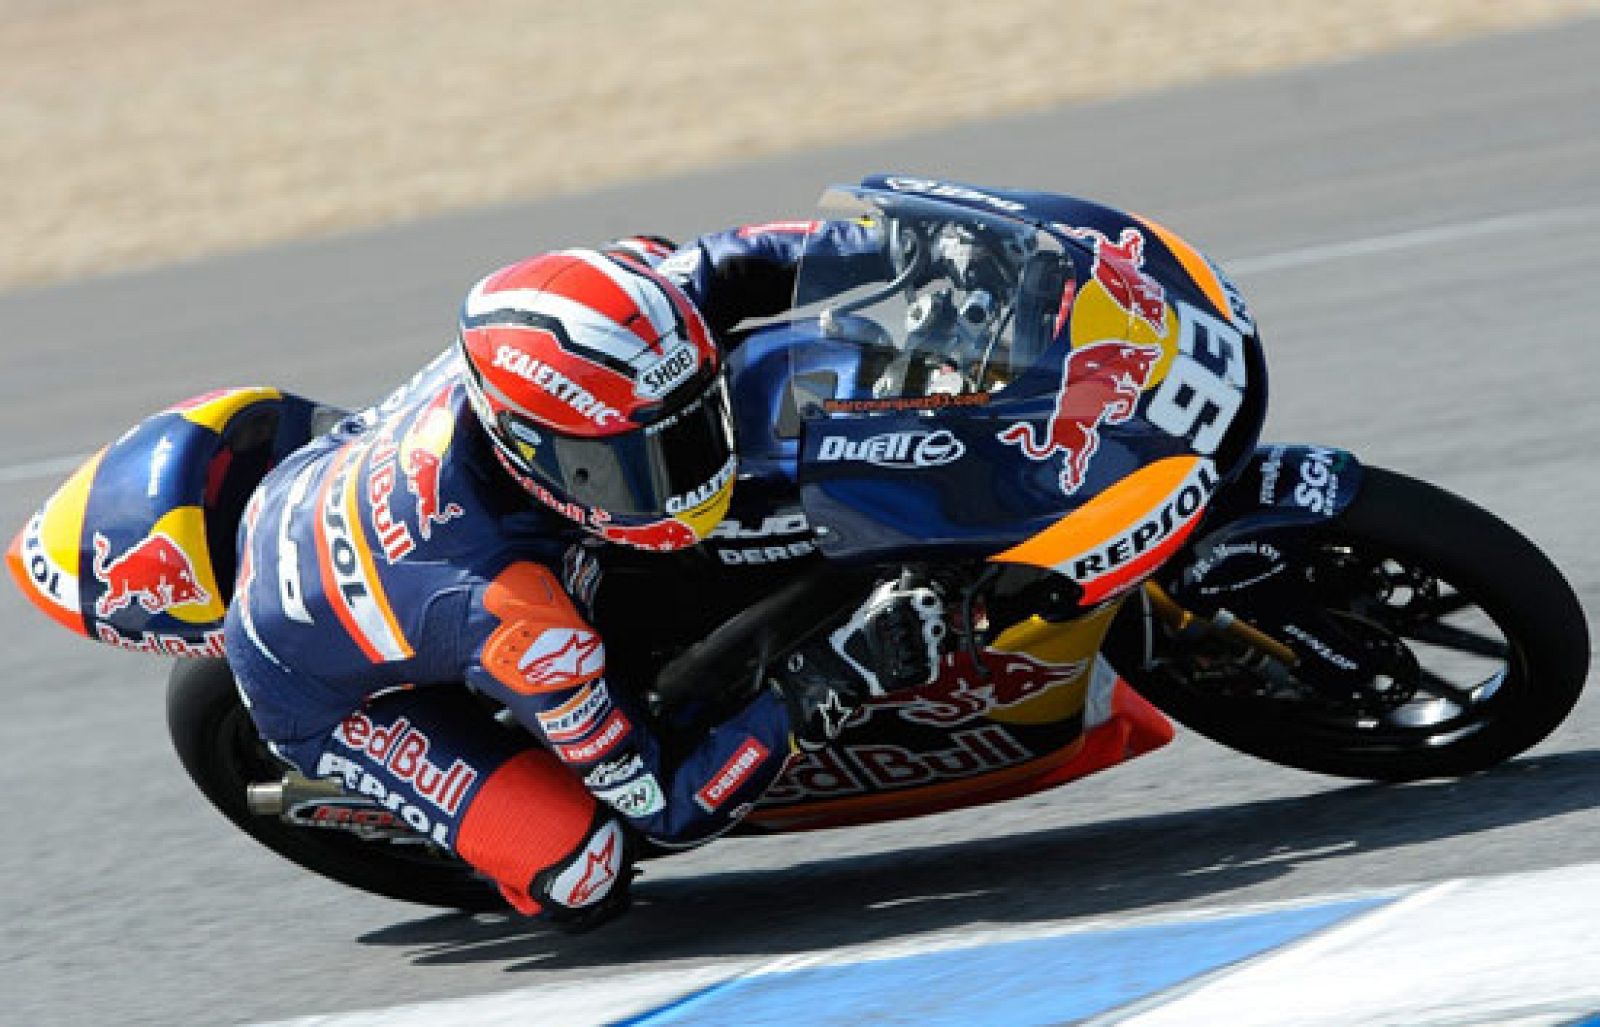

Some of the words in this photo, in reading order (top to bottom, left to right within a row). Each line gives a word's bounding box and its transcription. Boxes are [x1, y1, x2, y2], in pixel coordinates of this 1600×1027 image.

[492, 345, 622, 426] SCALEXTRIC
[1146, 299, 1247, 455] 93
[1073, 459, 1221, 581] REPSOL
[387, 722, 479, 818] Bull
[845, 722, 1036, 788] Bull
